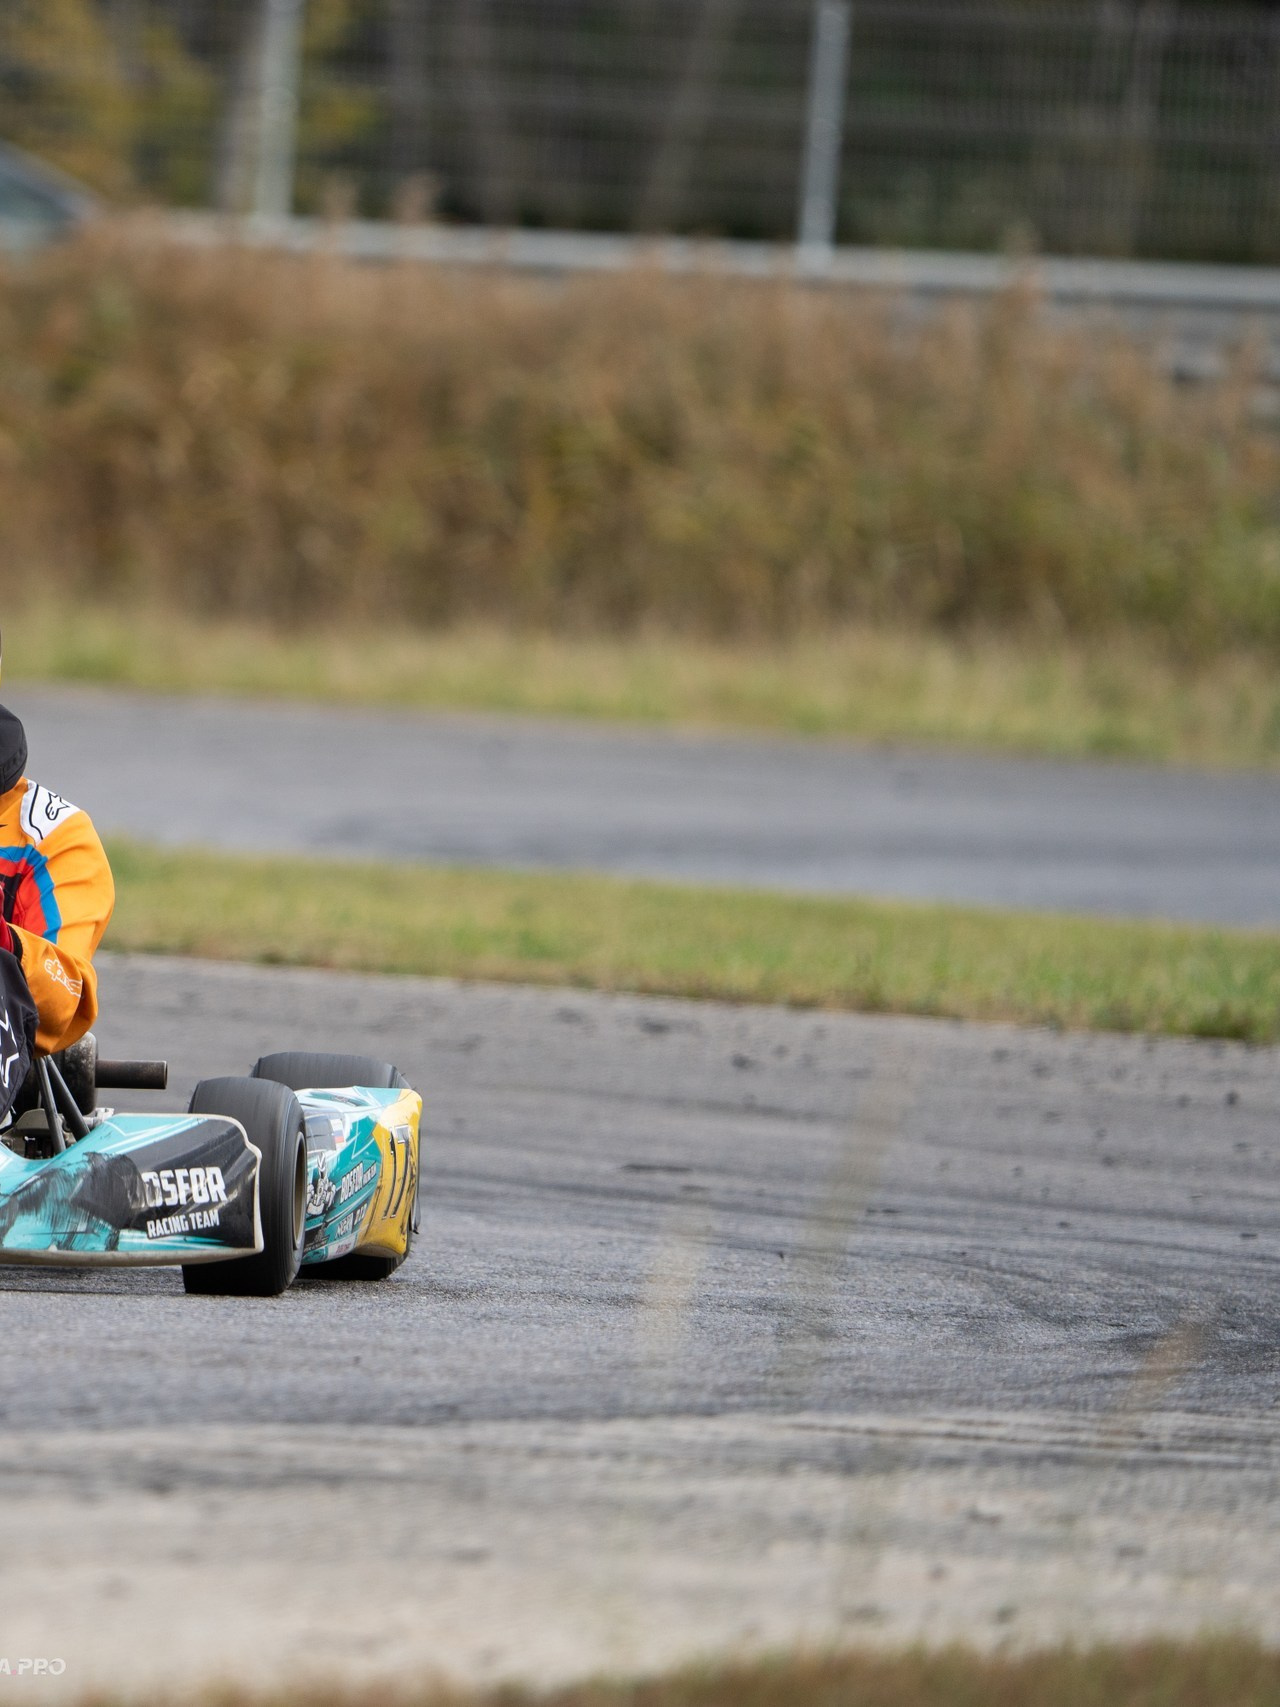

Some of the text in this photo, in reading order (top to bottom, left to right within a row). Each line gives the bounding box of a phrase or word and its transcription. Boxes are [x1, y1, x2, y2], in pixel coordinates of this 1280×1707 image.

[136, 1166, 228, 1208] OSFOR
[147, 1208, 220, 1238] RACING TEAM
